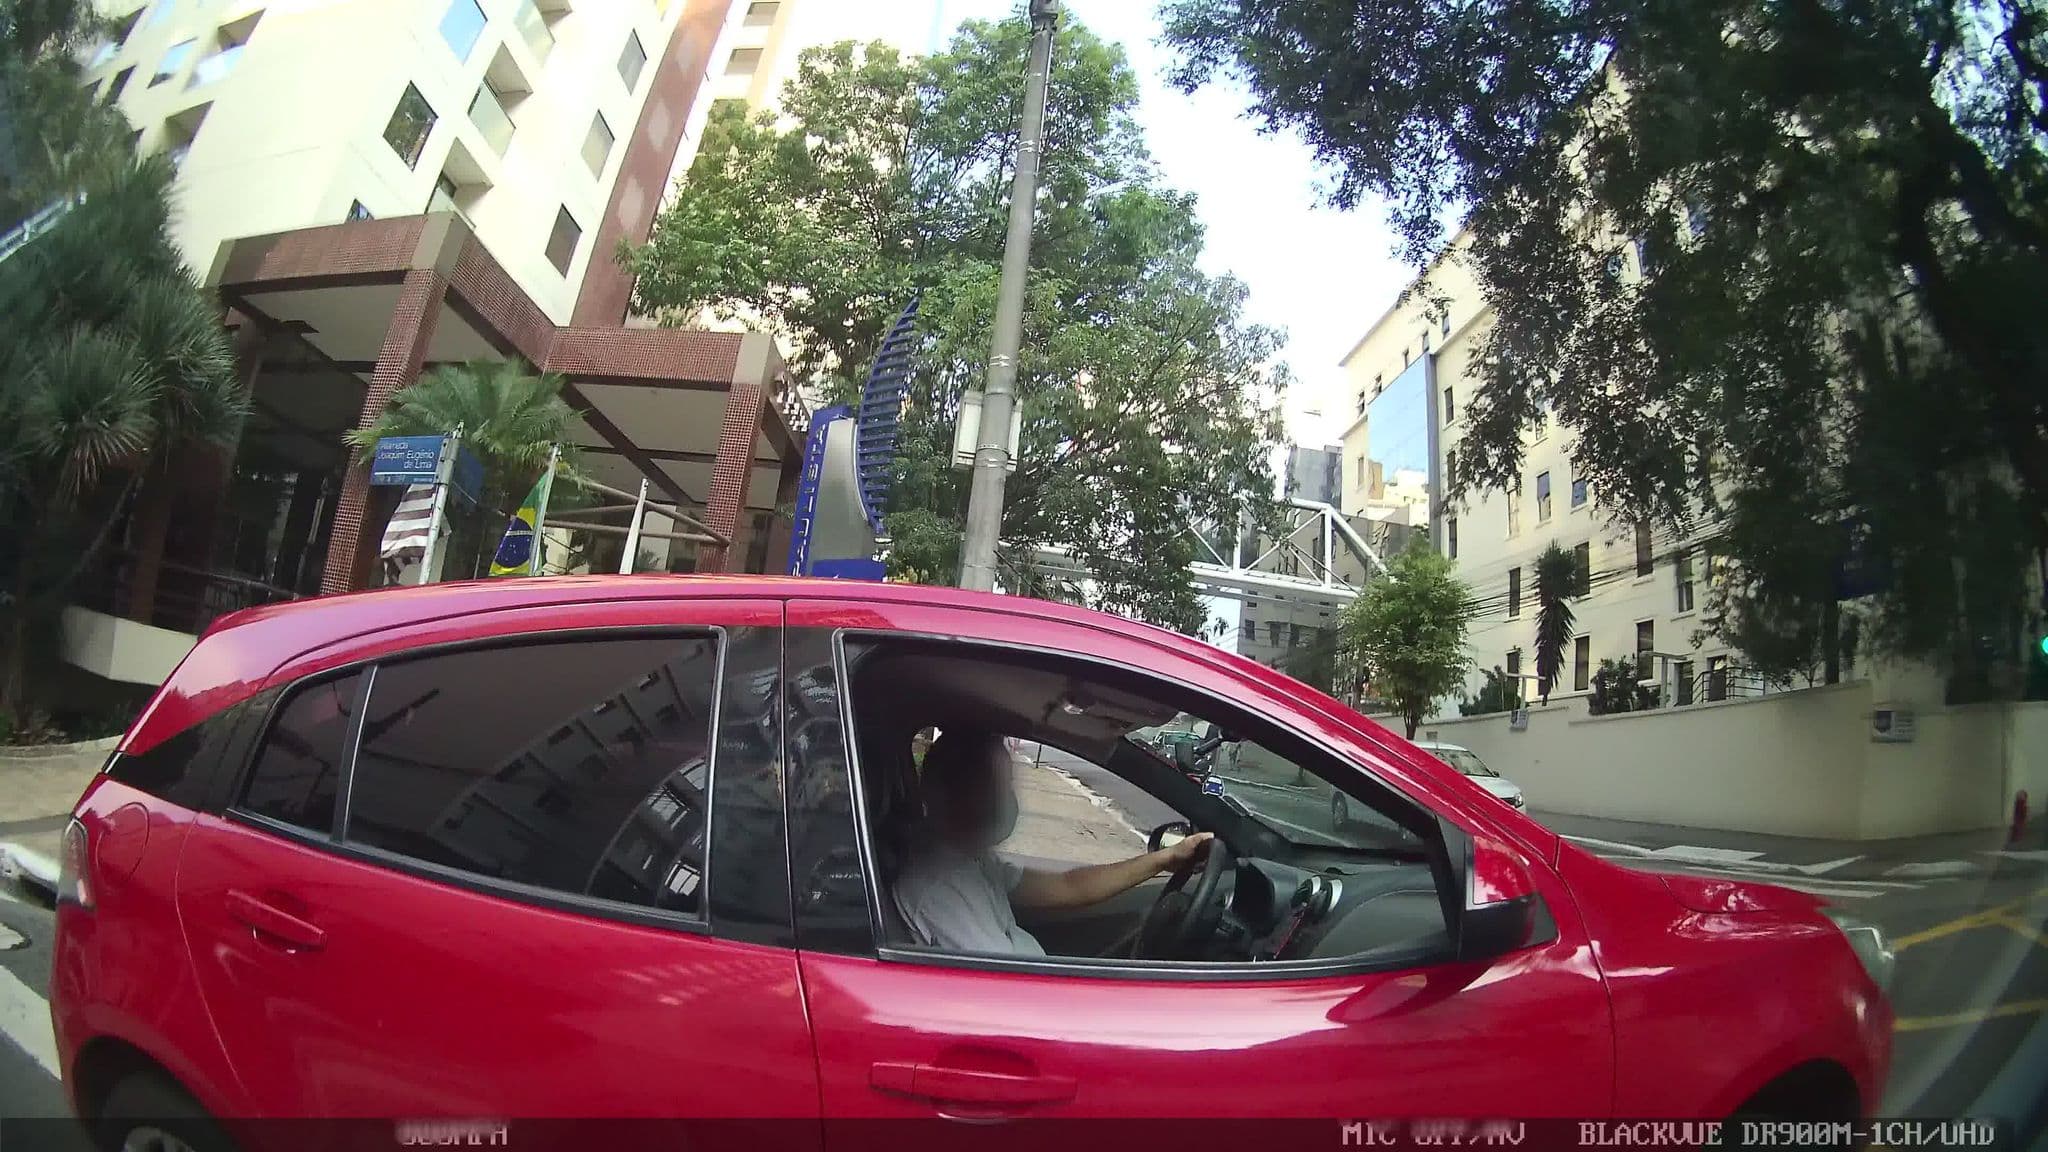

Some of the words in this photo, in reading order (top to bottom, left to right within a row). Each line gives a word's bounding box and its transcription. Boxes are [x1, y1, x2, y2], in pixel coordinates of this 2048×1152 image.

[406, 449, 435, 460] Eugênio
[403, 461, 413, 469] de
[414, 459, 432, 469] Lima
